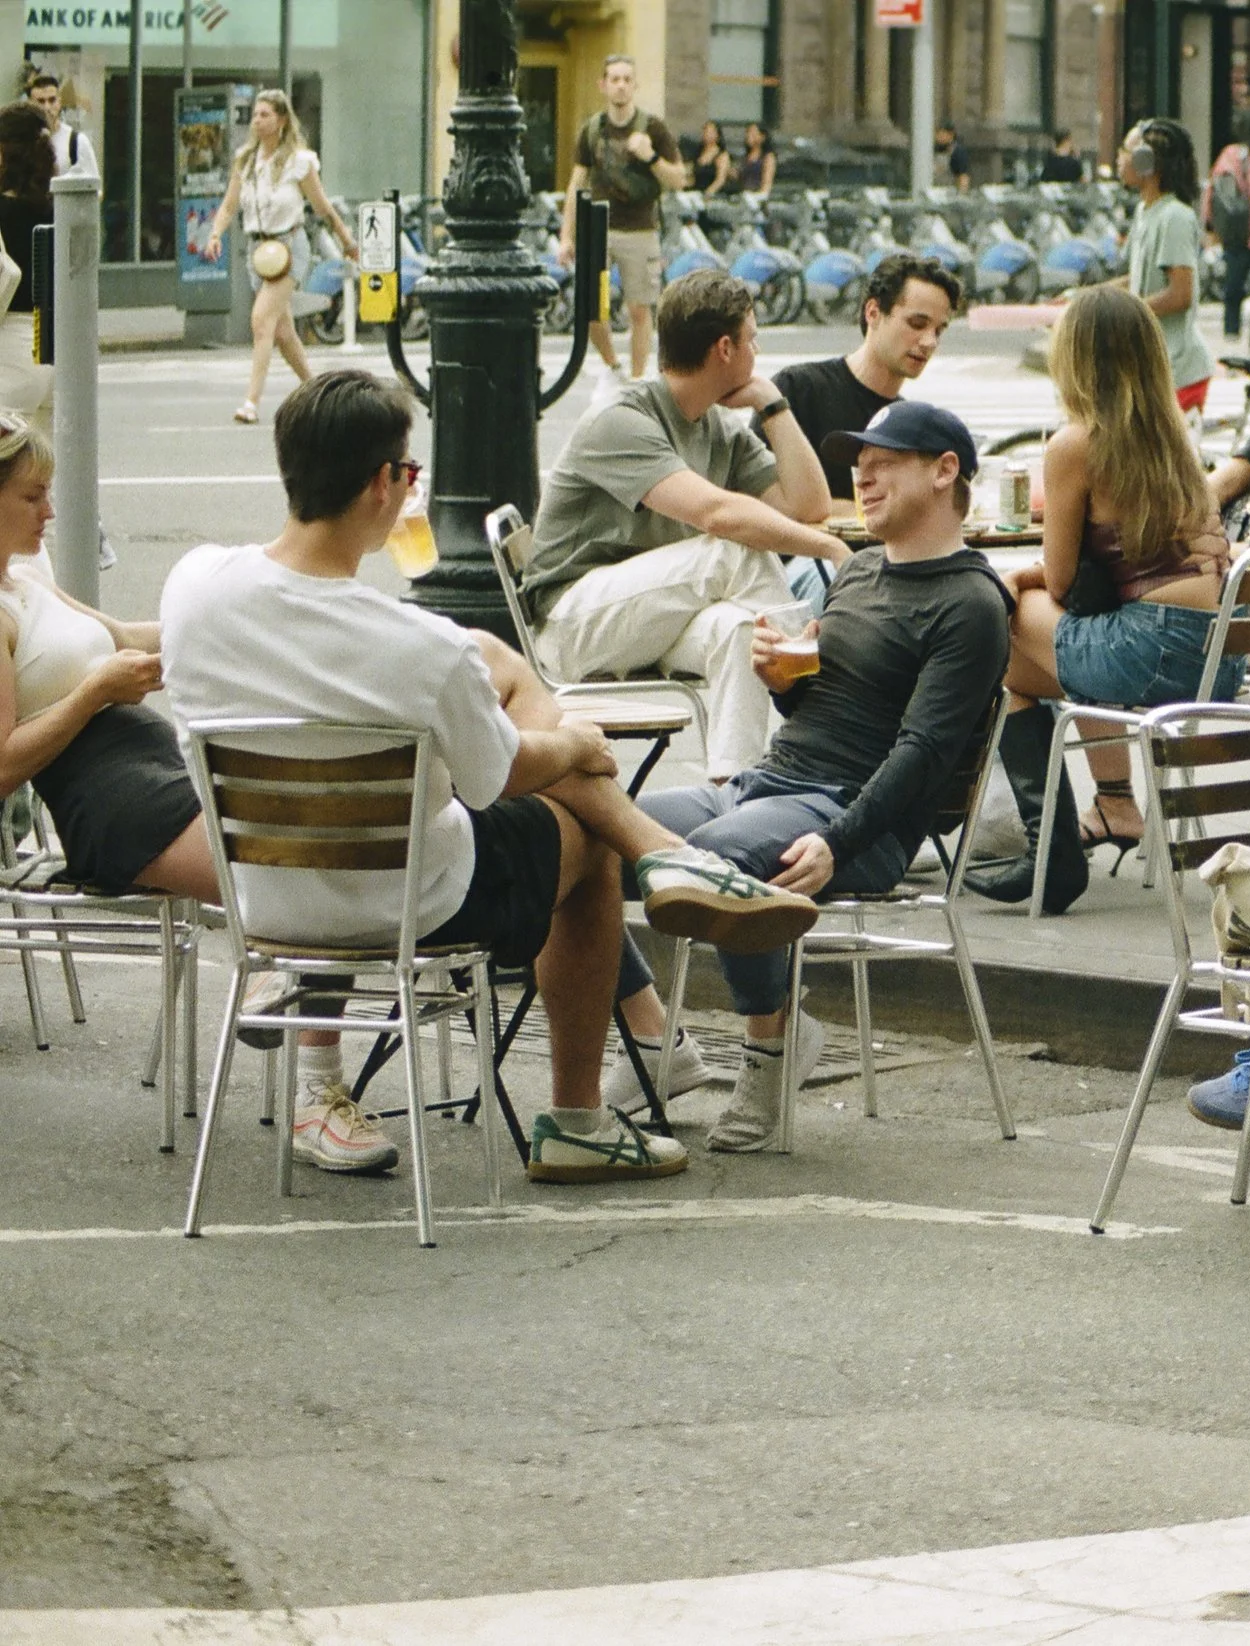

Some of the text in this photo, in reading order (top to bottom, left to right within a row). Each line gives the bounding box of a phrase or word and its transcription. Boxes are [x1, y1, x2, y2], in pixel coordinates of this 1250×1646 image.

[26, 8, 186, 30] ANK OF AMRICA
